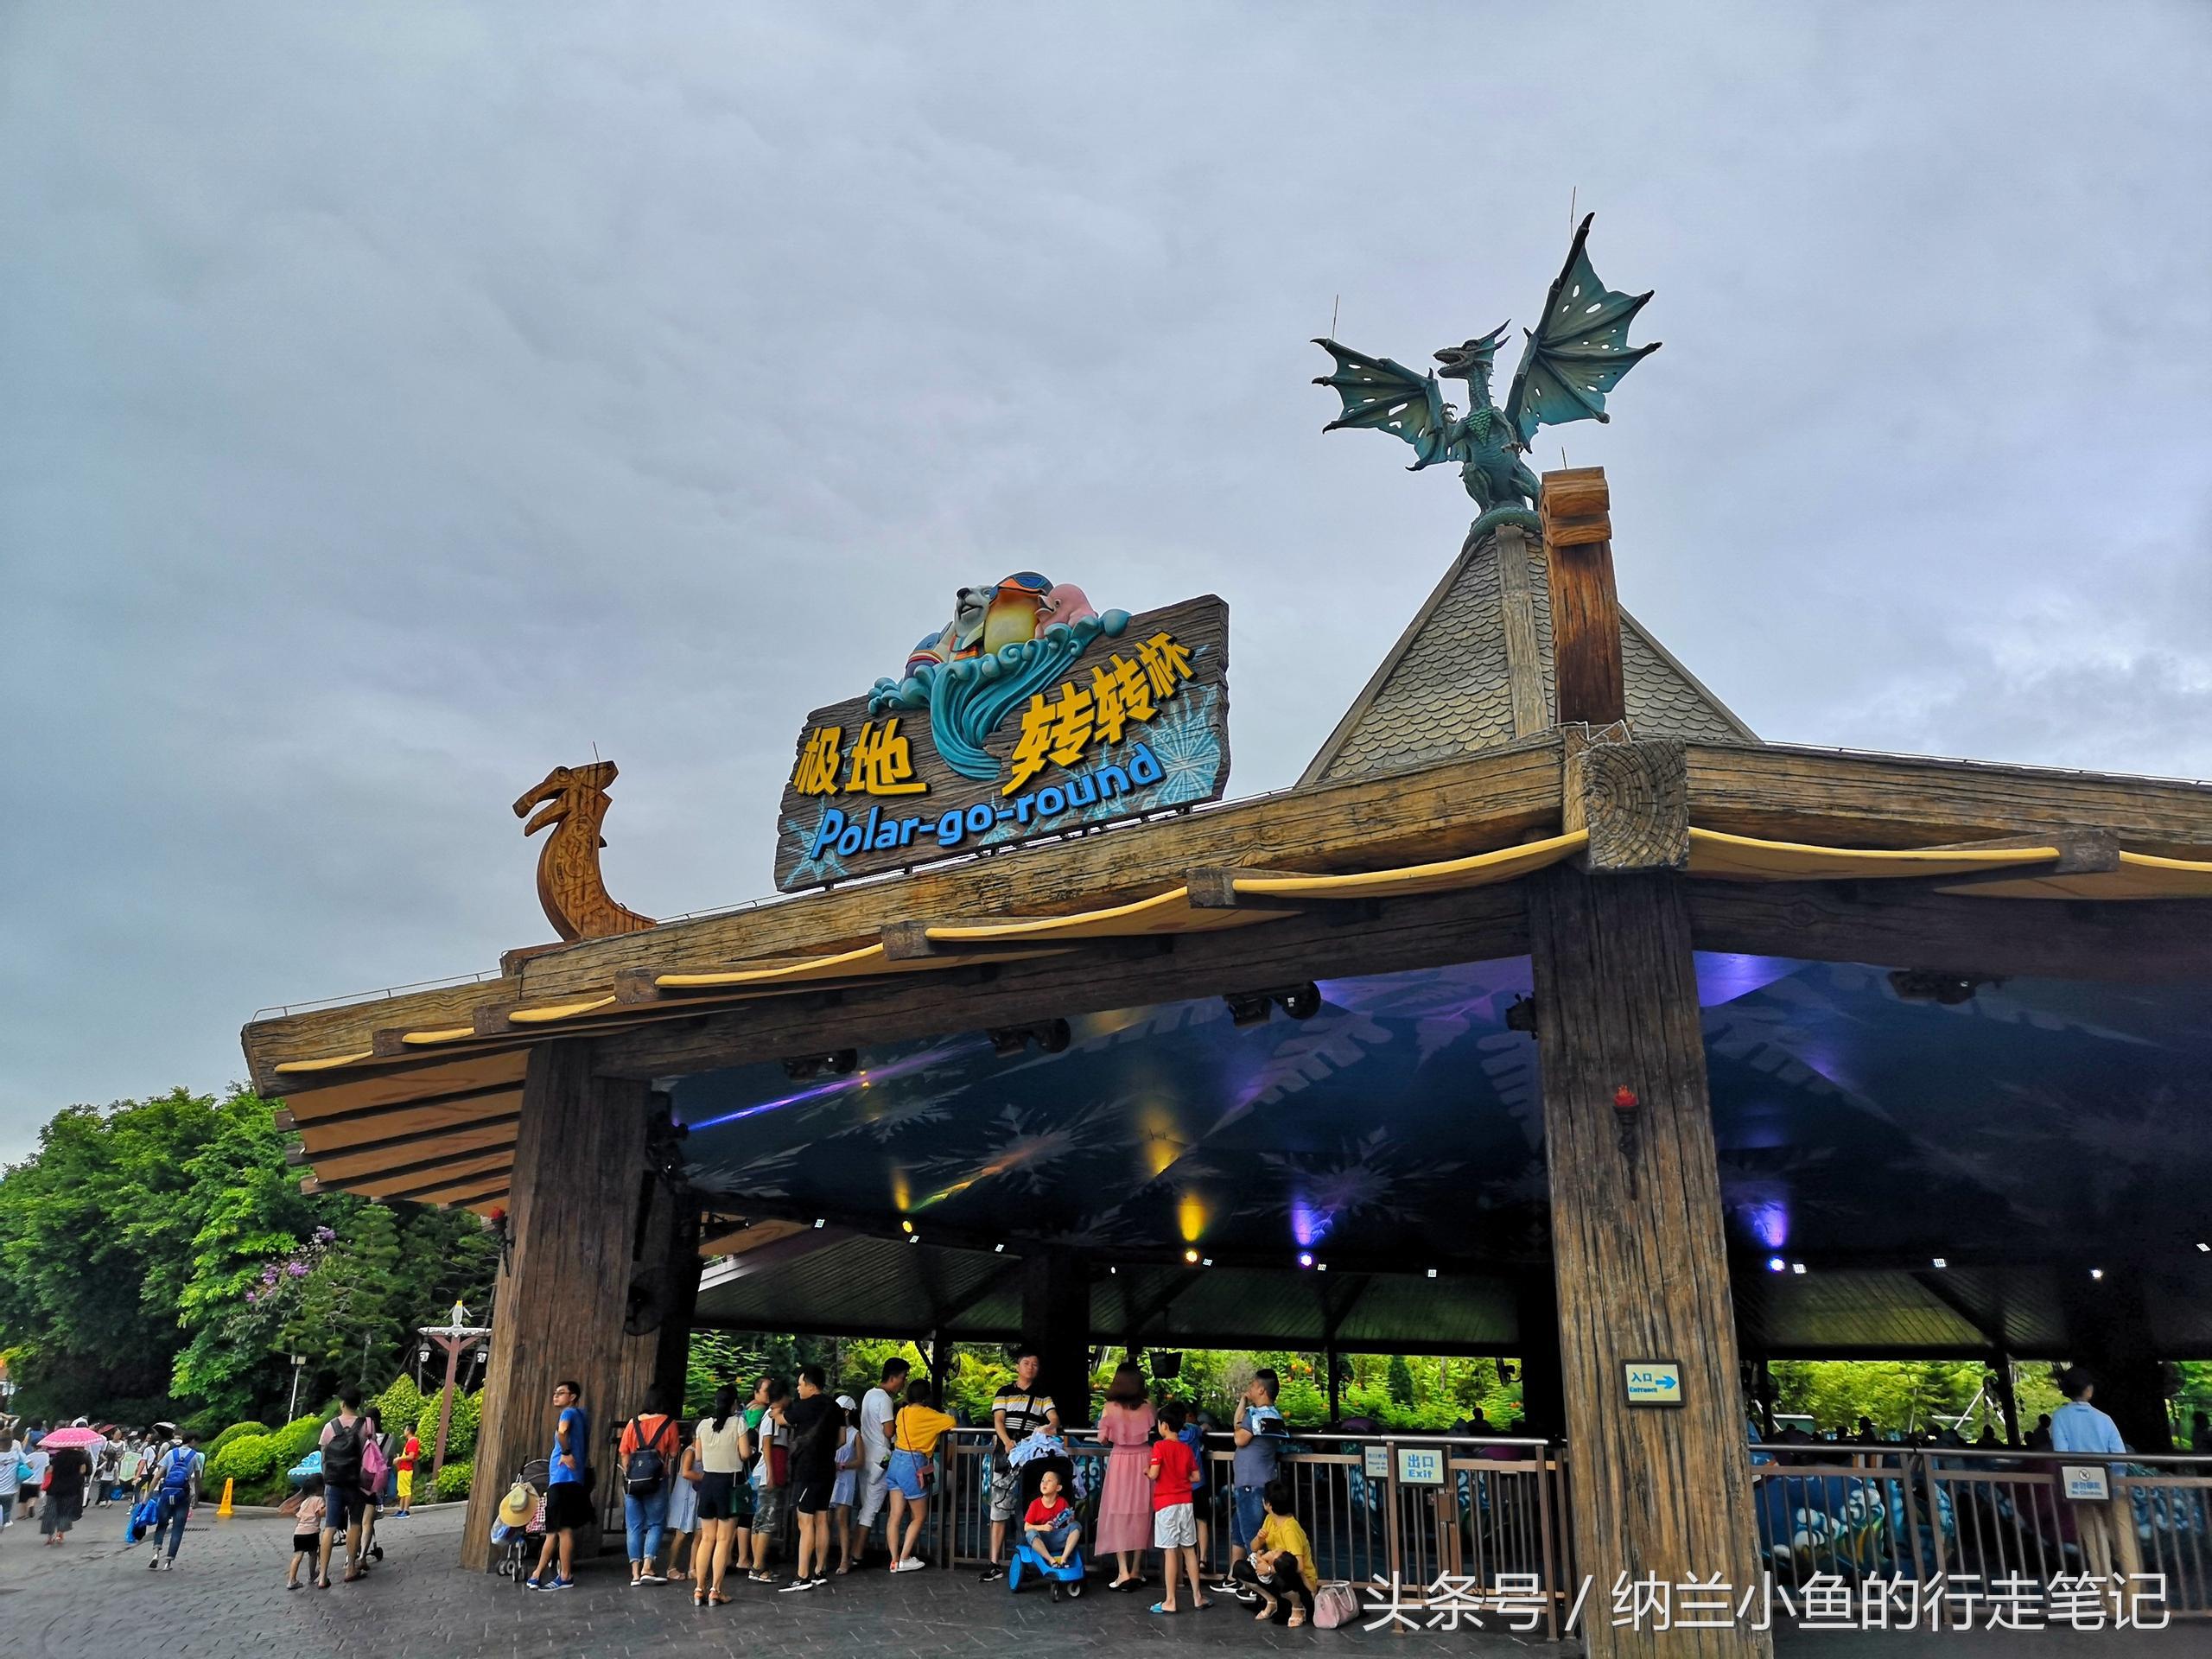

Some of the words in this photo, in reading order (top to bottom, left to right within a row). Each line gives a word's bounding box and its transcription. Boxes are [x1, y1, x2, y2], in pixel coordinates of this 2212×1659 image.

[792, 718, 931, 797] 极地
[1001, 631, 1196, 798] 转转杯
[810, 742, 1166, 861] Polar-go-round
[1631, 1372, 1652, 1382] 入口
[1408, 1454, 1433, 1468] 出口
[1408, 1470, 1433, 1478] Exit
